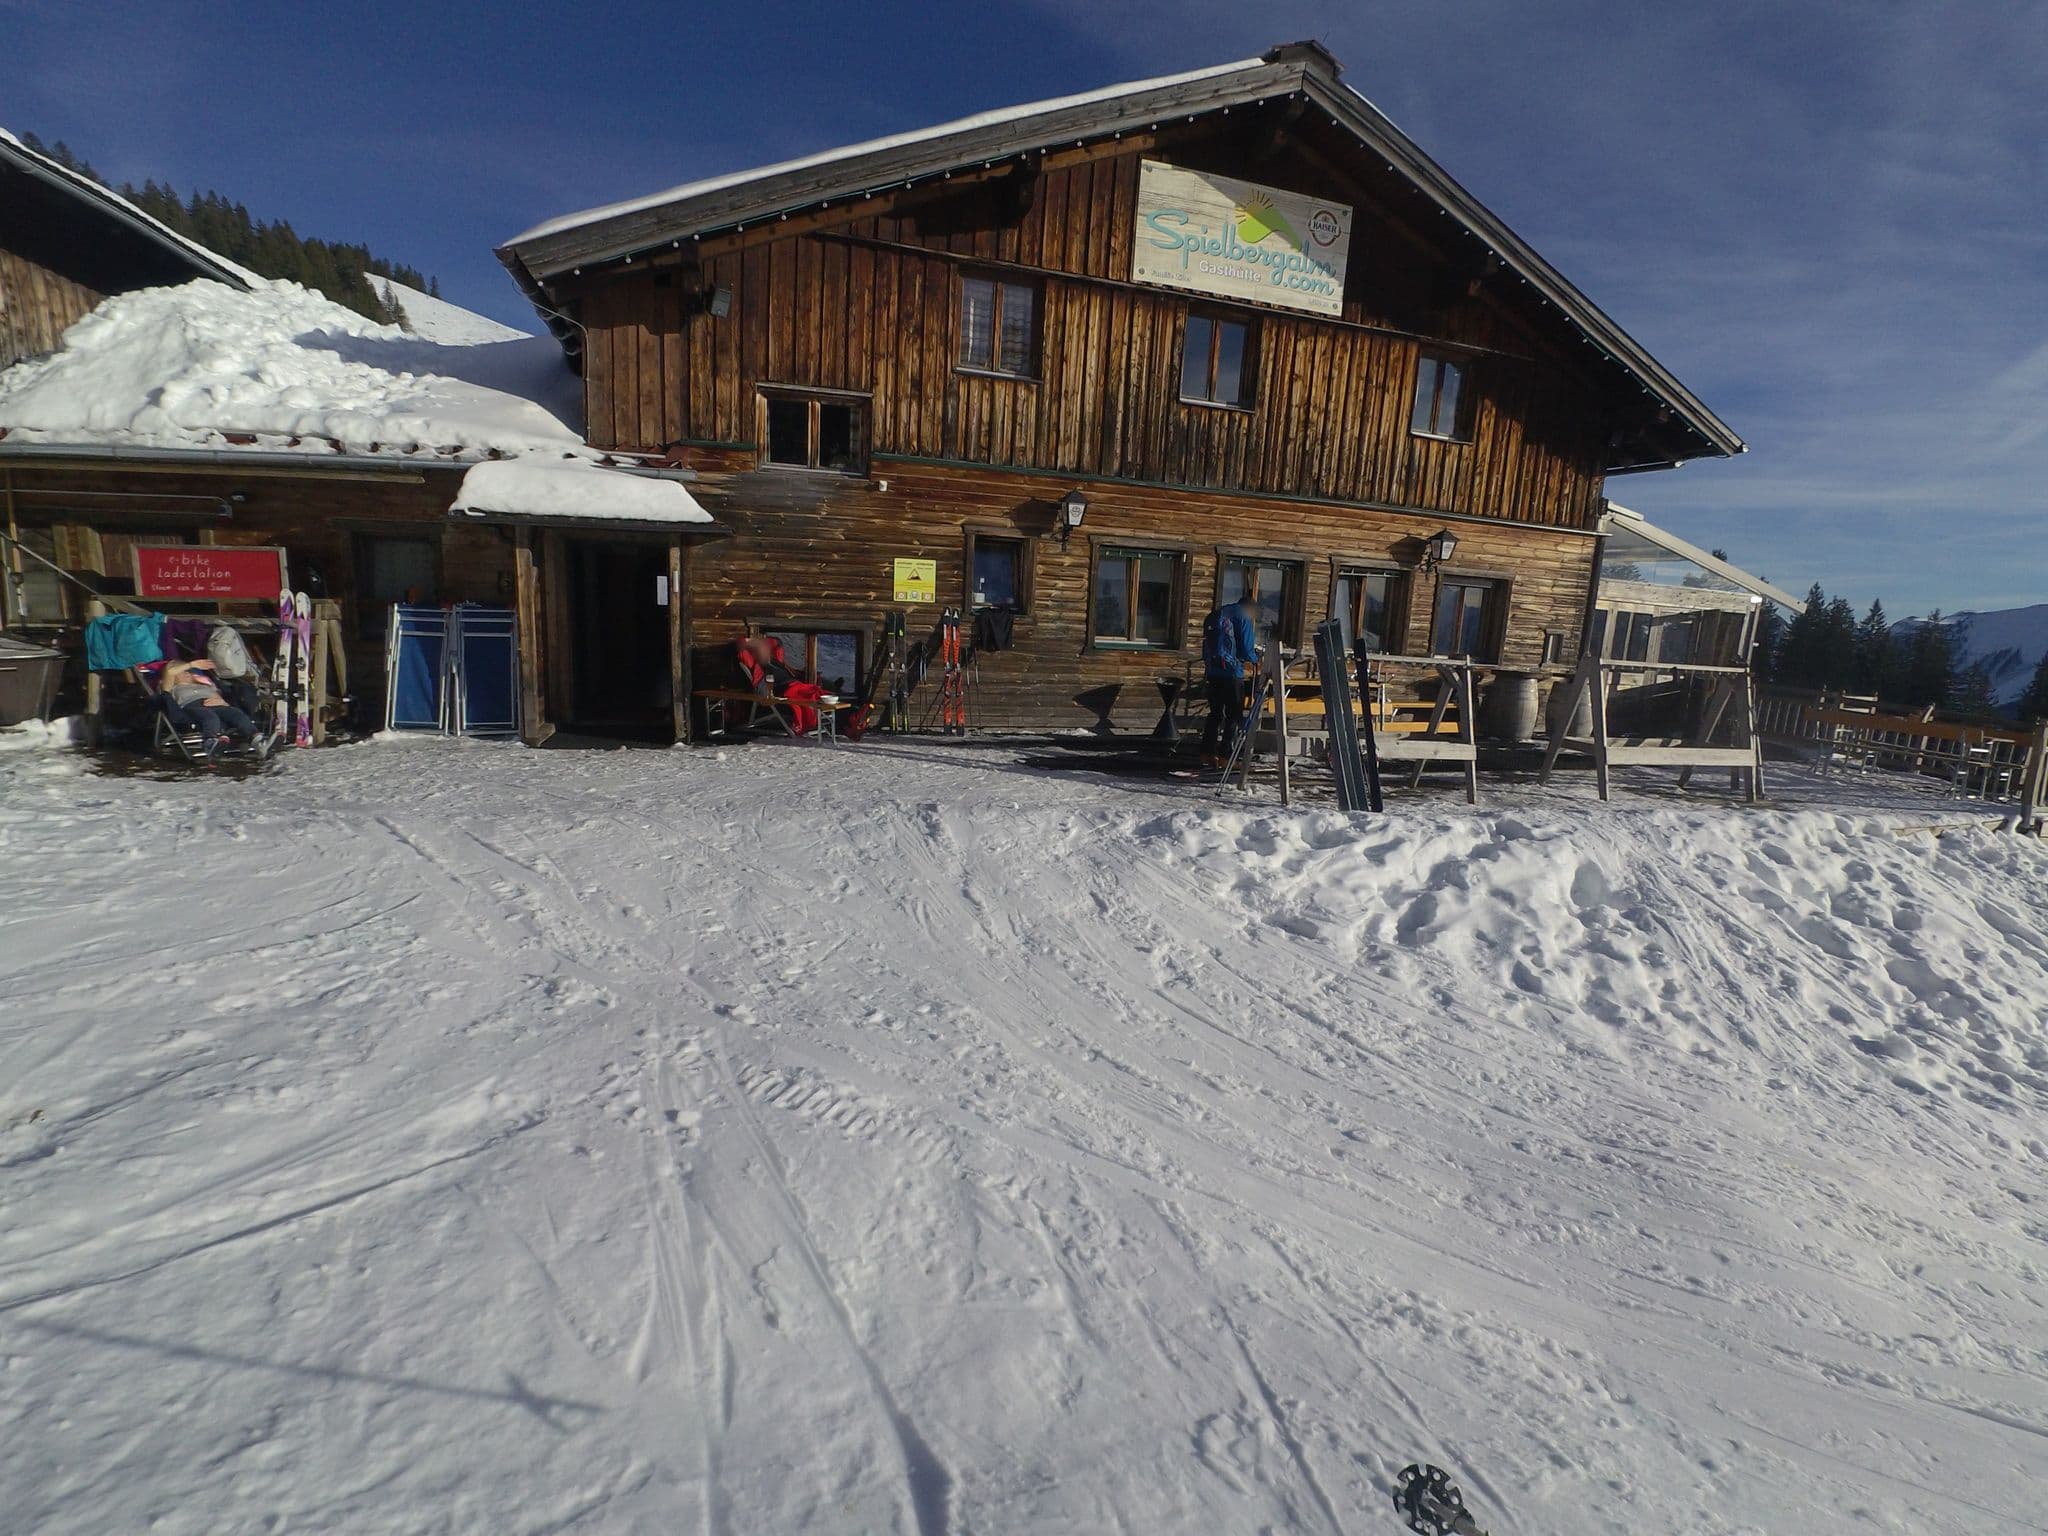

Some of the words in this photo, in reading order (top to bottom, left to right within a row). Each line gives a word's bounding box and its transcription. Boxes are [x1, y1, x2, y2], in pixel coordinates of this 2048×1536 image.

[1312, 220, 1337, 234] KAISER
[1146, 207, 1336, 287] Spielbergalm
[1199, 260, 1262, 283] Gasthütte
[1282, 272, 1335, 297] .com
[158, 565, 231, 578] Ladestation
